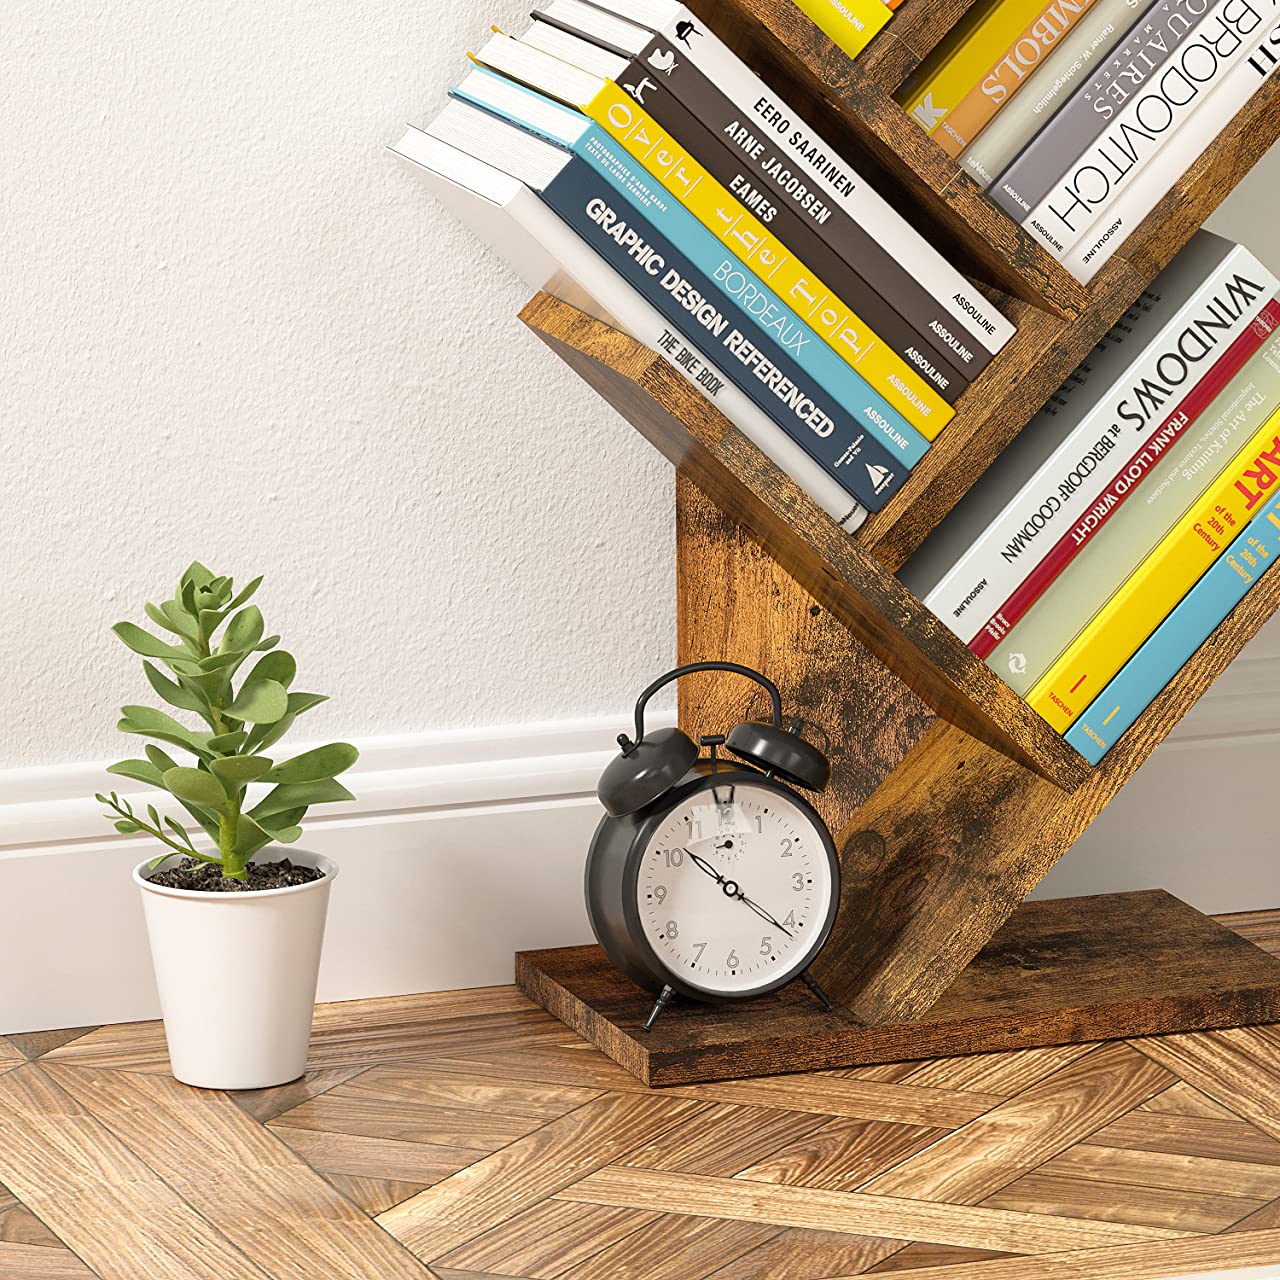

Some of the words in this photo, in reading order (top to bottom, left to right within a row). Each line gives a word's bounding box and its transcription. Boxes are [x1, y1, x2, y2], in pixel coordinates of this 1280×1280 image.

[1092, 23, 1115, 49] Rainer
[1080, 46, 1093, 61] W.
[1084, 23, 1153, 101] MARKETS
[1033, 60, 1082, 115] Schlegelmilch
[753, 96, 790, 134] EERO
[788, 131, 856, 198] SAARINEN
[941, 122, 967, 147] TASCHEN
[724, 120, 765, 160] ARNE
[761, 157, 832, 225] JACOBSEN
[729, 174, 778, 223] EAMES
[1002, 183, 1031, 212] ASSOULINE
[1030, 220, 1064, 252] ASSOULINE
[1082, 217, 1123, 264] ASSOULINE
[585, 198, 665, 276] GRAPHIC
[660, 270, 729, 338] DESIGN
[722, 329, 835, 439] REFERENCED
[713, 260, 810, 356] BORDEAUX
[952, 293, 996, 336] ASSOULINE
[928, 320, 974, 364] ASSOULINE
[1116, 273, 1266, 432] WINDOWS
[657, 329, 676, 354] THE
[674, 347, 699, 373] BIKE
[695, 368, 725, 396] BOOK
[904, 346, 950, 390] ASSOULINE
[886, 373, 932, 417] ASSOULINE
[1218, 381, 1256, 421] Inspirational
[1244, 392, 1266, 413] The
[863, 406, 909, 450] ASSOULINE
[1110, 423, 1122, 438] at
[1150, 411, 1190, 457] FRANK
[1219, 428, 1232, 442] of
[1230, 410, 1249, 431] Art
[1057, 433, 1116, 502] BERGDORF
[1115, 452, 1153, 495] LLOYD
[1167, 466, 1181, 481] and
[1182, 438, 1225, 481] Knitting
[1001, 496, 1061, 564] GOODMAN
[1071, 490, 1119, 546] WRIGHT
[1207, 517, 1225, 536] 20th
[1214, 504, 1225, 515] of
[1223, 512, 1236, 527] the
[1193, 523, 1220, 552] Century
[1247, 536, 1257, 547] of
[1255, 544, 1270, 559] the
[1225, 554, 1253, 584] Century
[1239, 548, 1258, 568] 20th
[953, 578, 988, 617] ASSOULINE
[1048, 692, 1073, 717] TASCHEN
[1081, 723, 1107, 749] TASCHEN
[686, 820, 703, 839] 11
[716, 808, 735, 827] 12
[755, 815, 763, 833] 1
[663, 847, 684, 867] 10
[780, 838, 793, 858] 2
[653, 885, 667, 905] 9
[792, 872, 805, 891] 3
[665, 920, 679, 940] 8
[782, 909, 796, 928] 4
[693, 942, 708, 964] 7
[726, 949, 740, 969] 6
[759, 936, 772, 955] 5
